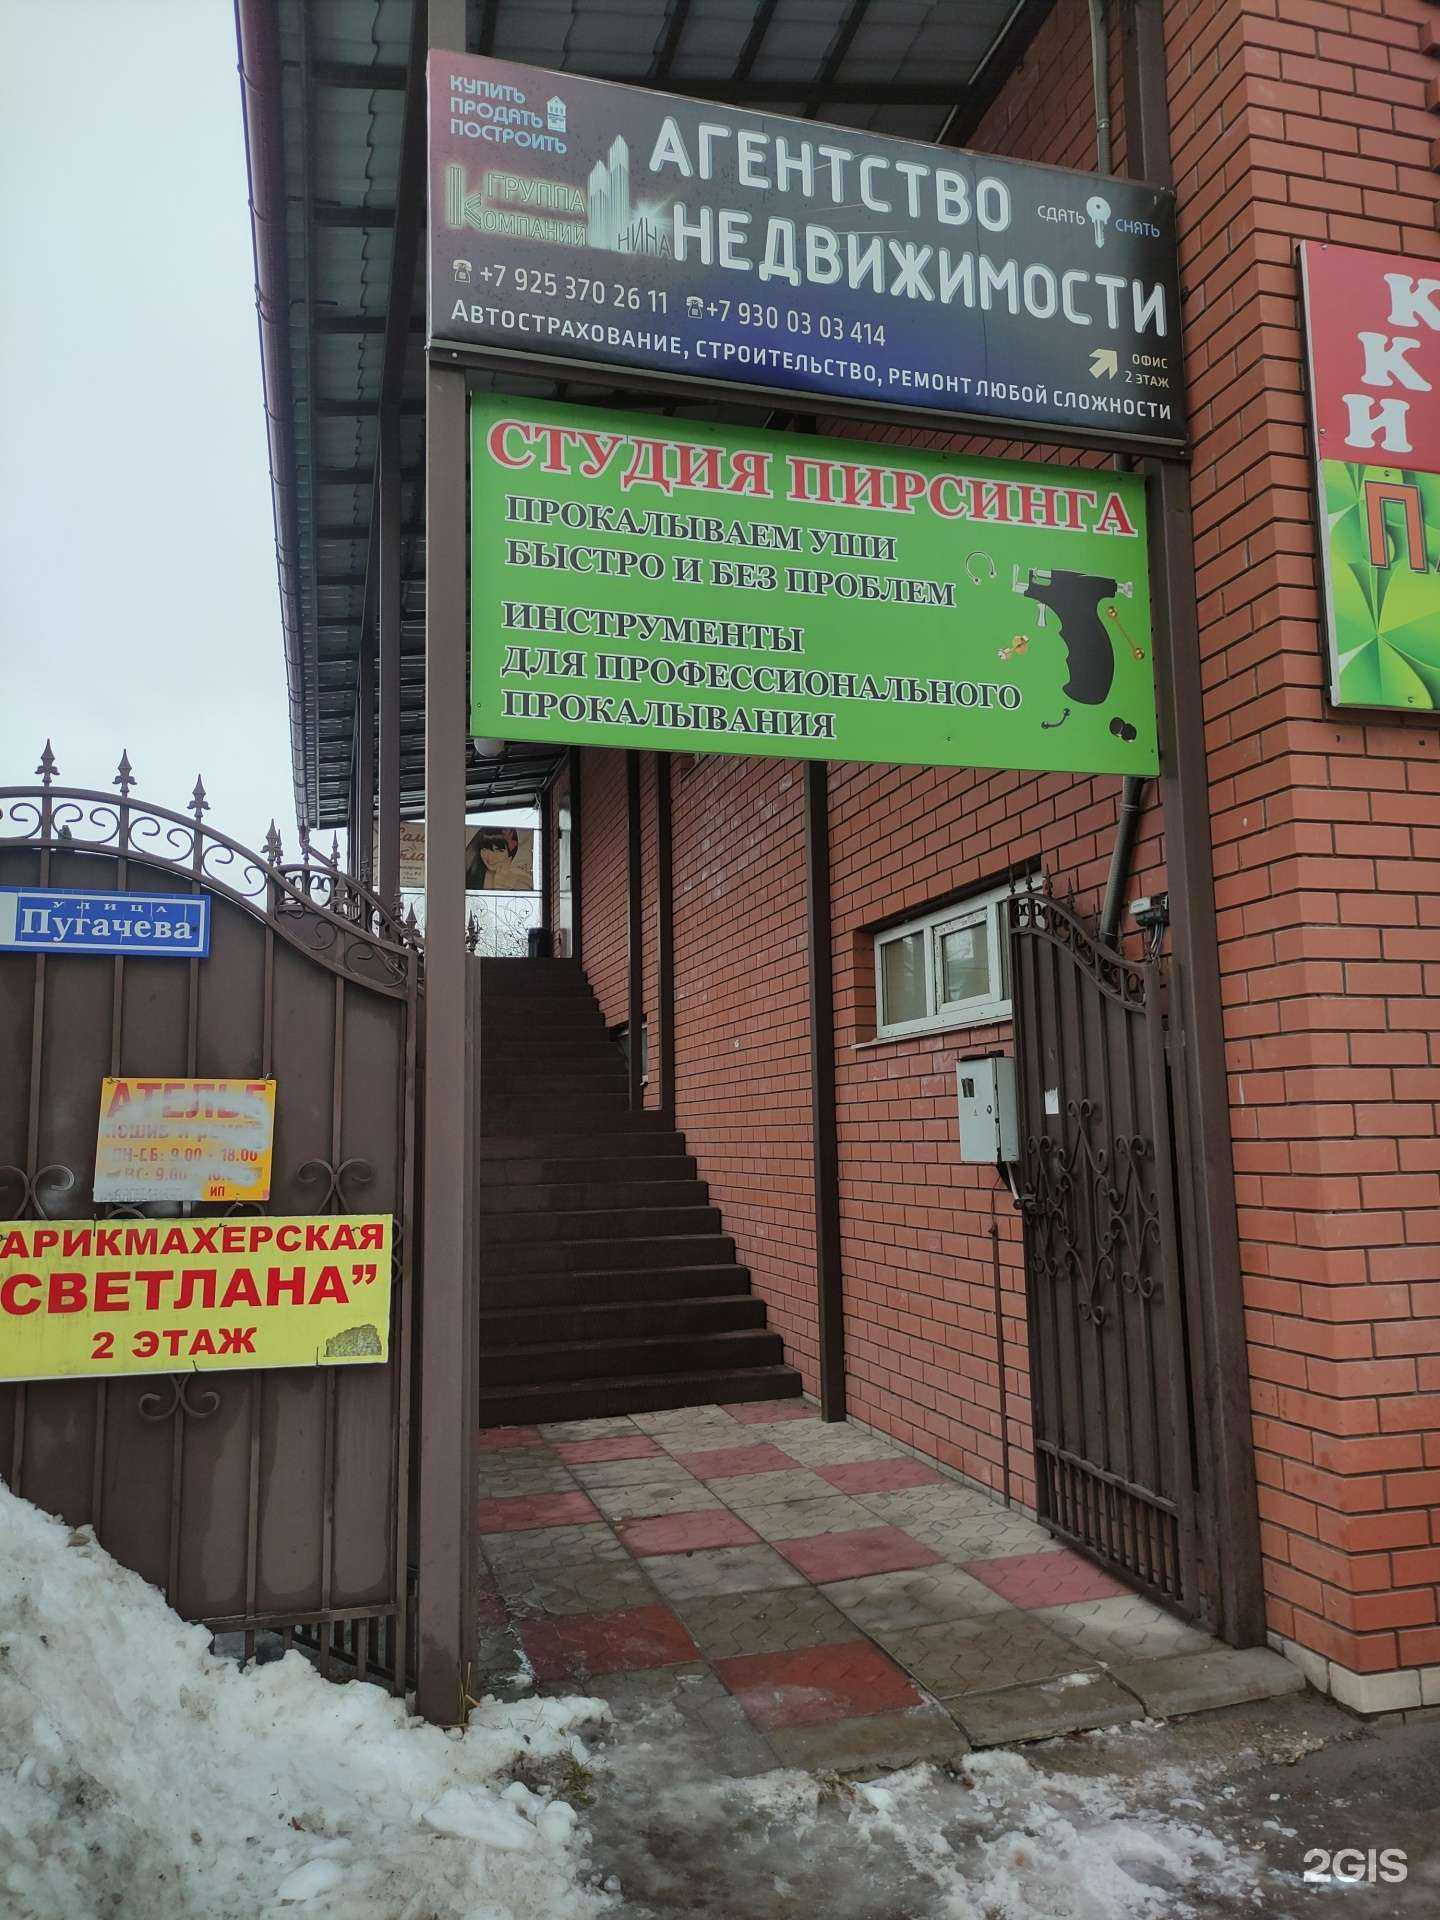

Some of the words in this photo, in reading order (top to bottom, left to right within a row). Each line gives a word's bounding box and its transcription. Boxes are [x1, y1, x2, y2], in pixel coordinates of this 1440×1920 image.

[450, 74, 526, 104] КУПИТЬ
[450, 96, 543, 128] ПРОДАТЬ
[450, 118, 567, 154] ПОСТРОИТЬ
[487, 173, 585, 213] ГРУППА
[650, 115, 1011, 232] АГЕНТСТВО
[450, 166, 588, 247] КОМПАНИЙ
[1037, 204, 1086, 226] СДАТЬ
[1115, 218, 1161, 238] СНЯТЬ
[617, 216, 673, 257] НИНА
[480, 263, 506, 288] +7
[513, 267, 558, 296] 925
[565, 275, 605, 305] 370
[613, 283, 640, 310] 26
[648, 289, 668, 314] 11
[673, 201, 1167, 337] НЕДВИЖИМОСТИ
[706, 299, 731, 322] +7
[738, 302, 778, 329] 930
[786, 310, 812, 335] 03
[819, 315, 844, 341] 03
[850, 320, 886, 347] 414
[451, 298, 690, 360] АВТОСТРАХОВАНИЕ,
[696, 339, 883, 388] СТРОИТЕЛЬСТВО,
[889, 367, 973, 395] РЕМОНТ
[976, 379, 1048, 405] ЛЮБОЙ
[1053, 389, 1172, 421] СЛОЖНОСТИ
[1124, 370, 1133, 384] 2
[1136, 372, 1170, 389] ЭТАЖ
[1132, 352, 1169, 370] ОФИС
[1342, 395, 1413, 453] И
[488, 419, 773, 498] СТУДИЯ
[786, 456, 1138, 538] ПИРСИНГА
[505, 495, 802, 552] ПРОКАЛЫВАЕМ
[808, 528, 897, 562] УШИ
[1363, 479, 1440, 575] П
[505, 540, 664, 581] БЫСТРО
[673, 557, 702, 584] И
[711, 561, 777, 591] БЕЗ
[785, 567, 957, 608] ПРОБЛЕМ
[502, 601, 805, 654] ИНСТРУМЕНТЫ
[501, 646, 587, 680] ДЛЯ
[595, 653, 1023, 710] ПРОФЕССИОНАЛЬНОГО
[502, 689, 837, 740] ПРОКАЛЫВАНИЯ
[21, 908, 193, 943] Пугачева
[210, 1186, 225, 1198] ИП
[91, 1331, 115, 1360] 2
[131, 1327, 257, 1358] ЭТАЖ
